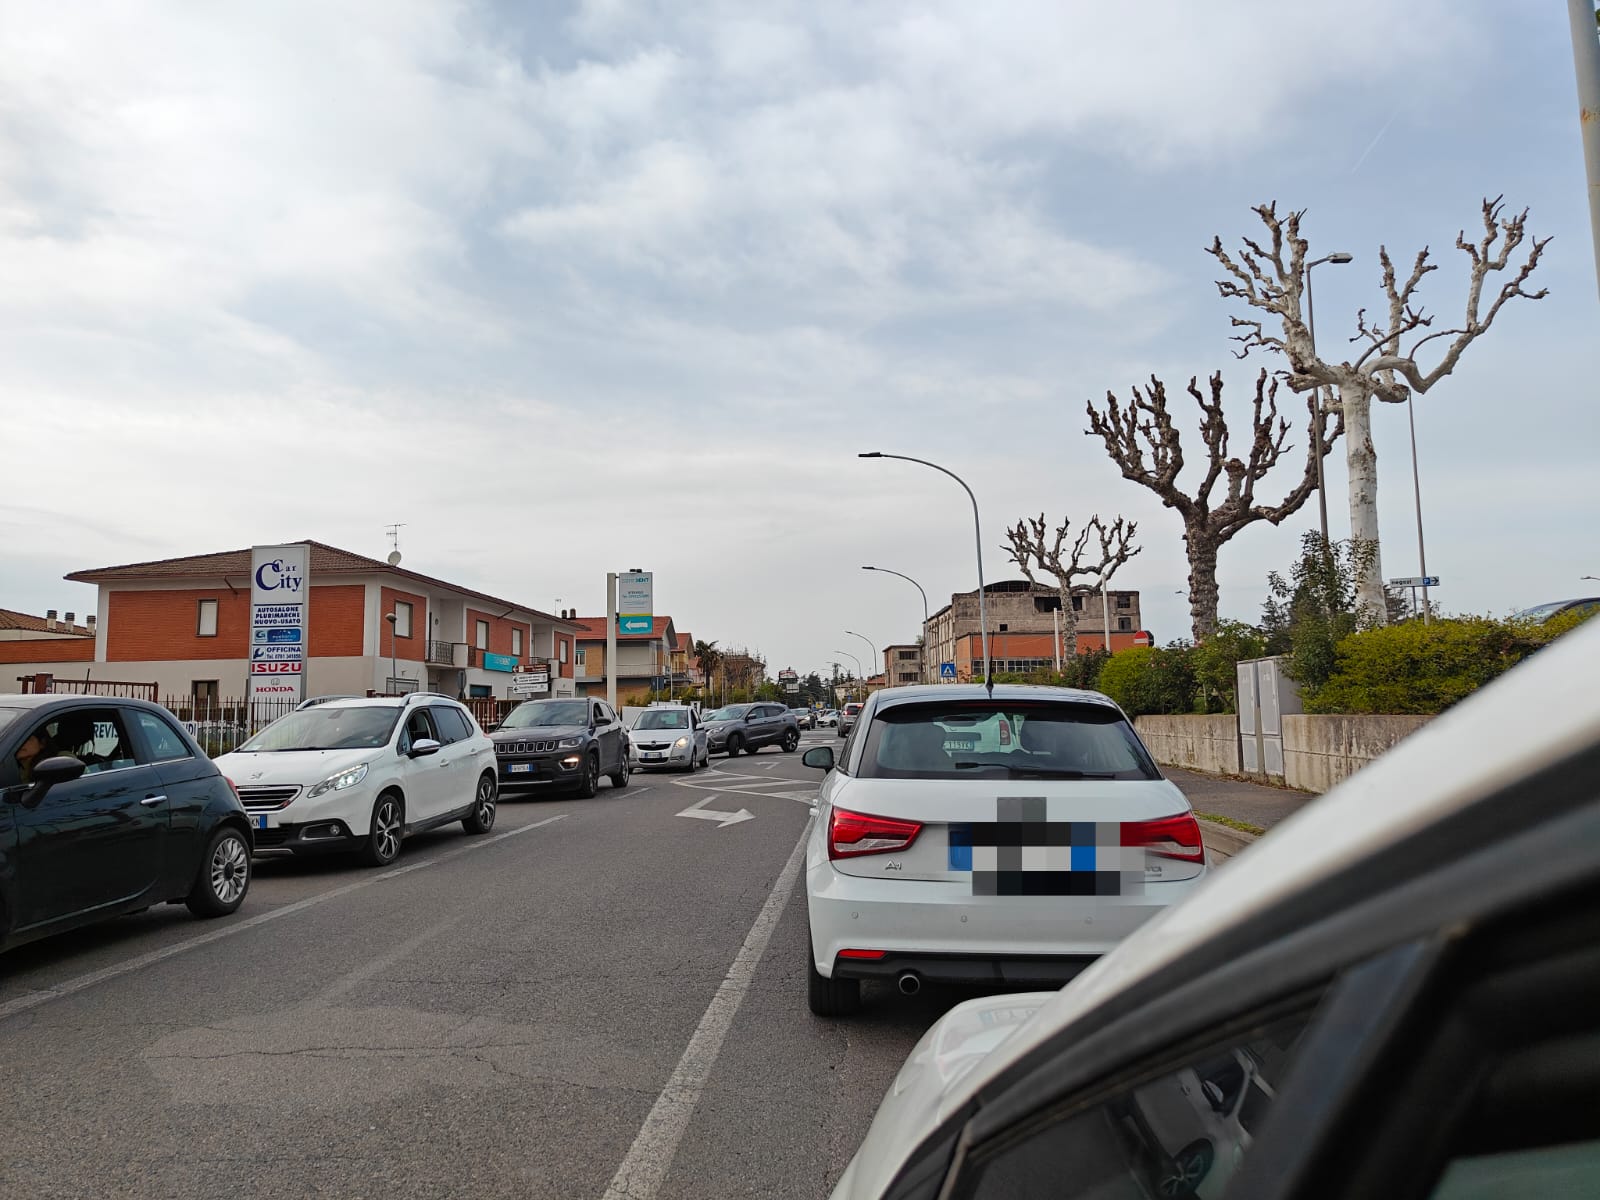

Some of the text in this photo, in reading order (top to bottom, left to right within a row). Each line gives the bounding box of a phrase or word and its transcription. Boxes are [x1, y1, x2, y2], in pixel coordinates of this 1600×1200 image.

[272, 559, 296, 572] Car
[255, 562, 302, 592] City
[251, 663, 302, 673] ISUZU
